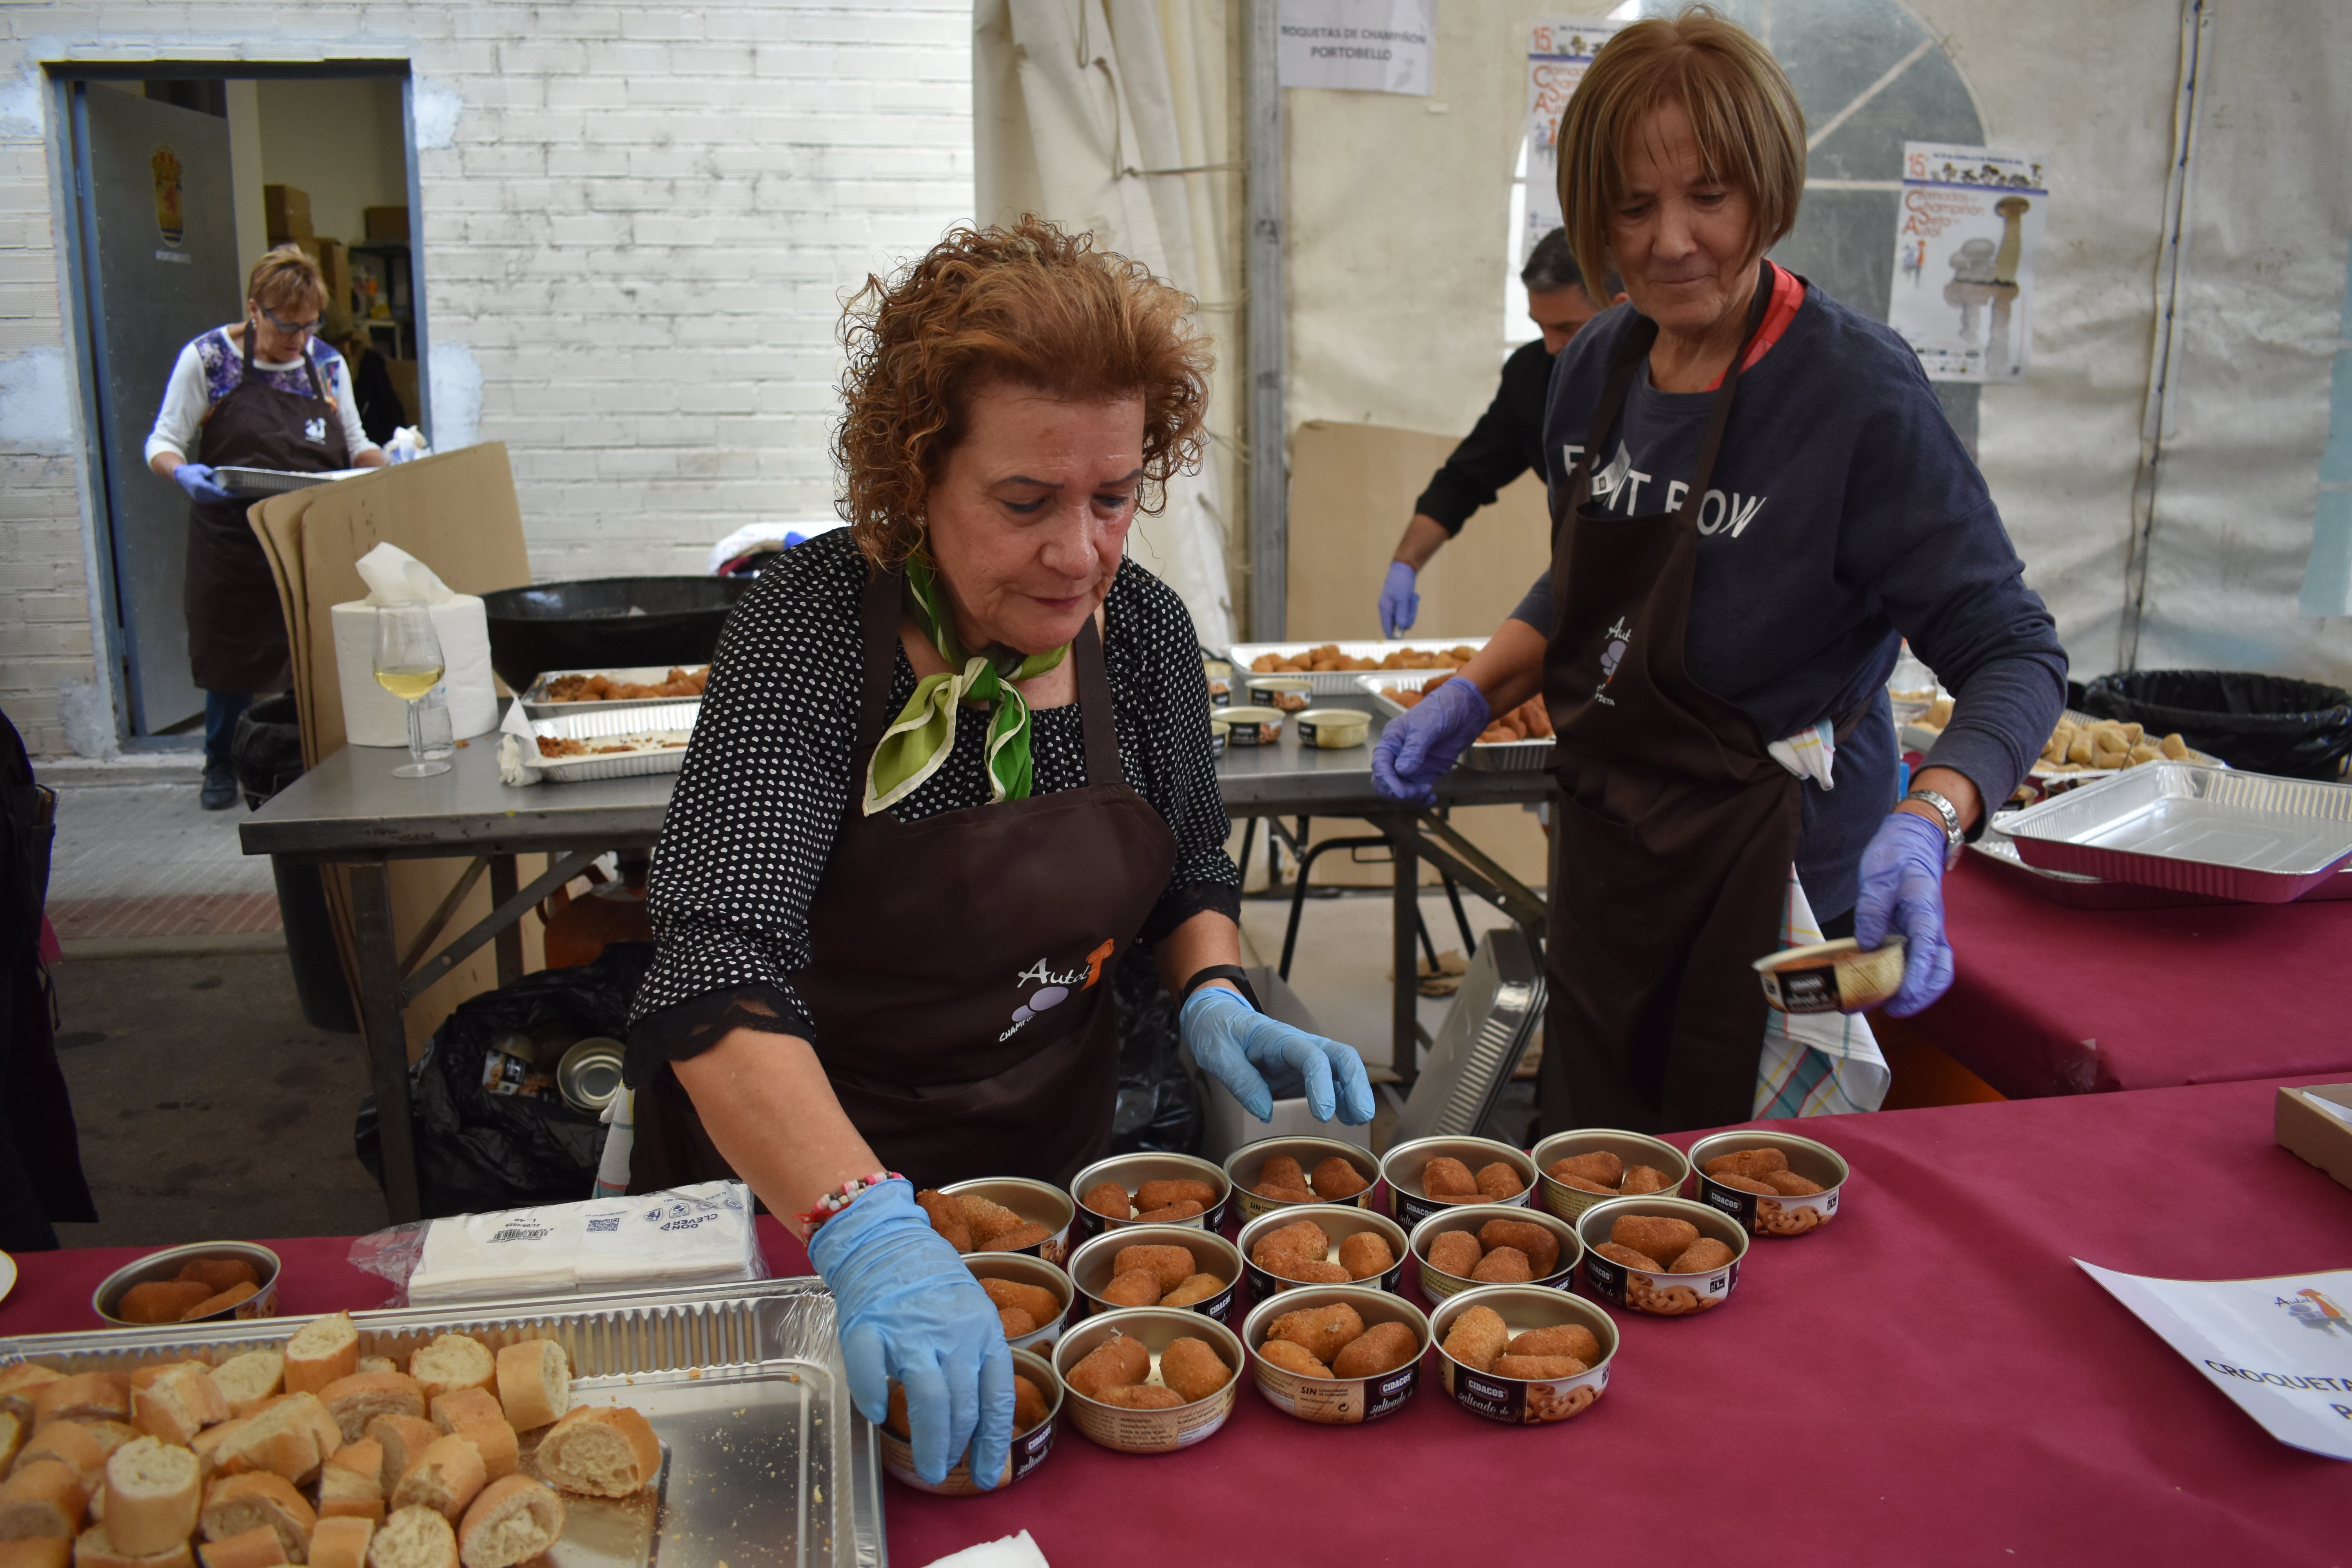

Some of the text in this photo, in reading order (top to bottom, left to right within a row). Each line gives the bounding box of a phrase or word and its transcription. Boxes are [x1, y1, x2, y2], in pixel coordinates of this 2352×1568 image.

[1343, 28, 1357, 38] DE
[1310, 45, 1392, 61] PORTOBELLO
[1017, 957, 1091, 988] Autol
[1250, 1201, 1261, 1211] SIN
[1711, 1192, 1739, 1209] CIDACOS
[673, 1213, 718, 1225] CLEVER
[1588, 1259, 1610, 1280] CIDACOS
[1210, 1294, 1231, 1315] CIDACOS
[2274, 1296, 2313, 1307] Autol
[1301, 1387, 1317, 1396] SIN
[1383, 1374, 1411, 1392] CIDACOS
[1468, 1379, 1505, 1398] CIDACOS
[1369, 1391, 1406, 1414] salteado
[1457, 1392, 1509, 1415] salteado de
[1028, 1423, 1052, 1450] CIDACOS
